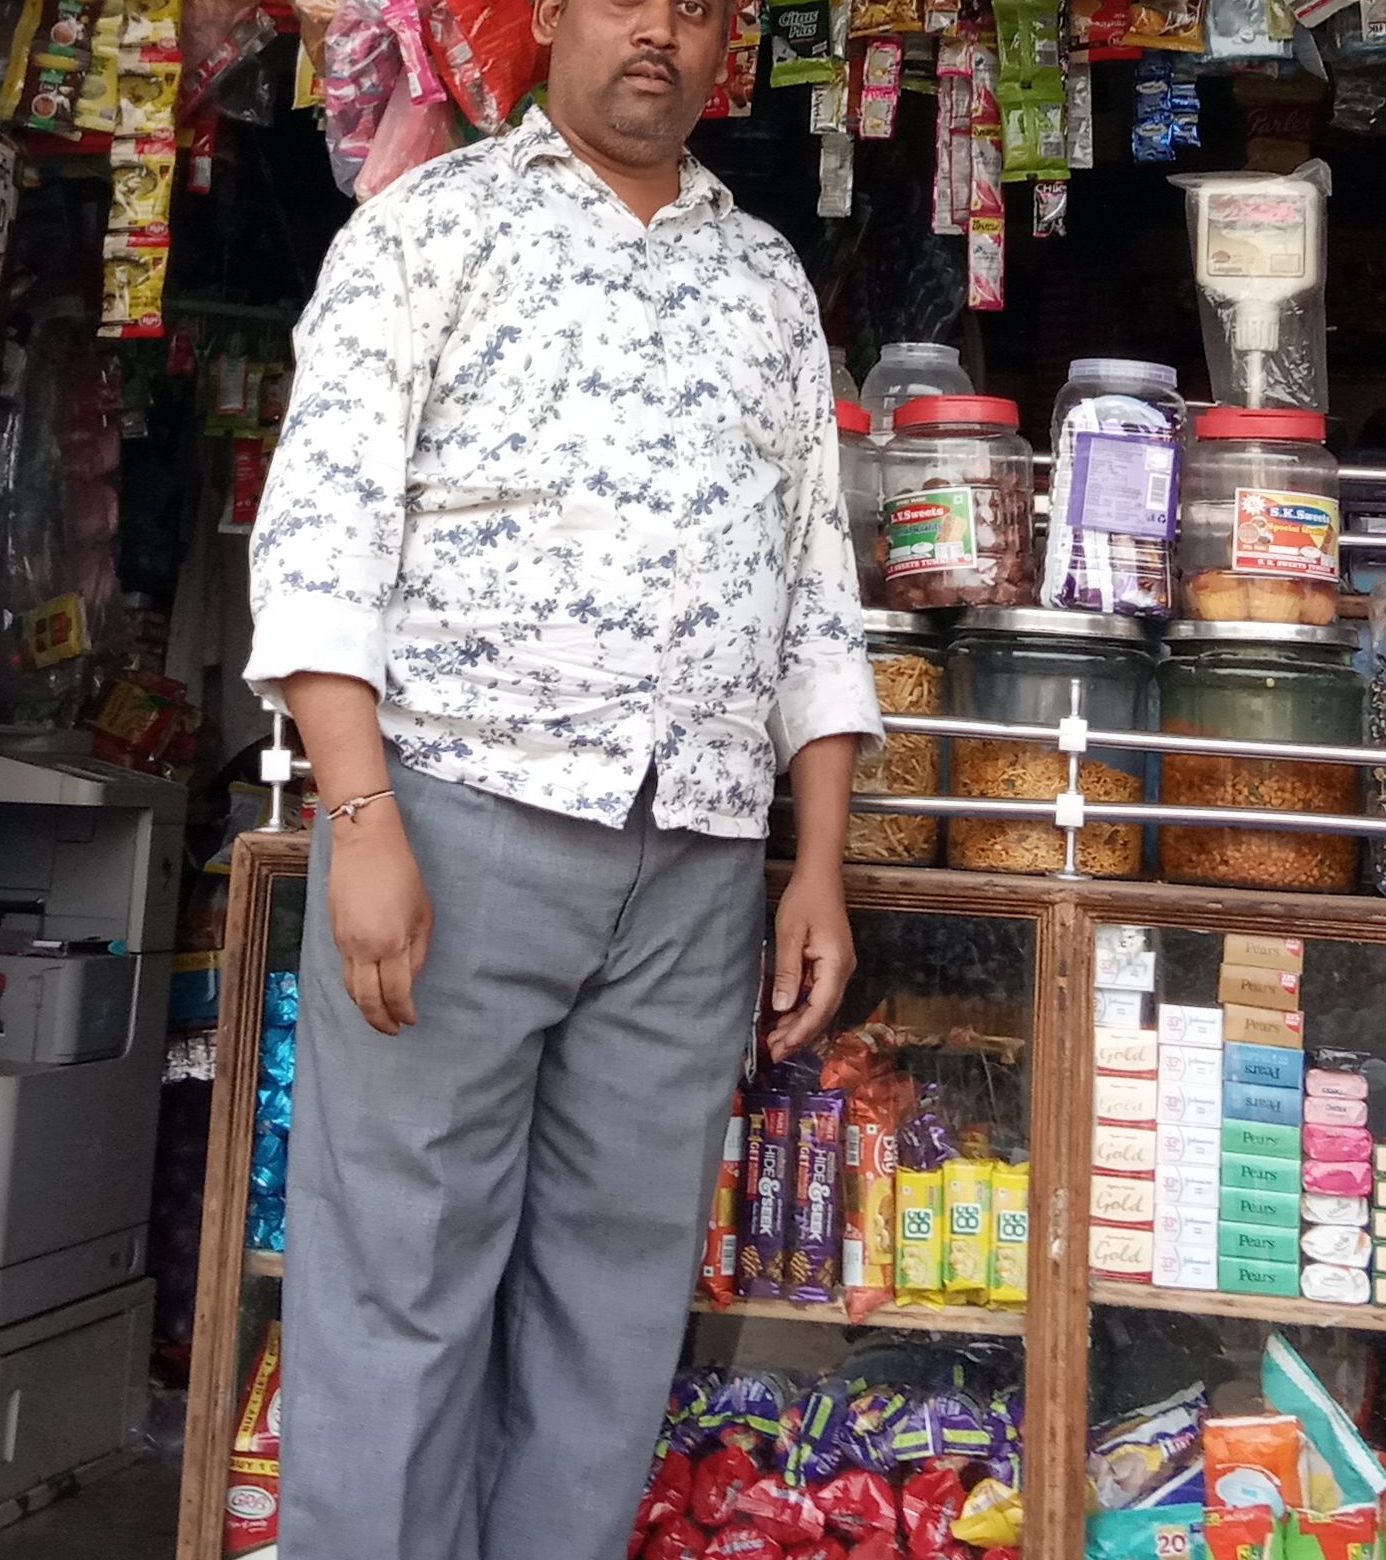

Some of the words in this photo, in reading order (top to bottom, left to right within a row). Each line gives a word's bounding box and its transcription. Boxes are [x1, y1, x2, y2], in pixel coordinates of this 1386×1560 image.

[778, 10, 819, 28] Citrus
[788, 23, 817, 39] Plus
[764, 1143, 777, 1183] HIDE
[813, 1149, 827, 1186] HIDE
[1240, 1164, 1278, 1182] Pears
[758, 1176, 781, 1201] &
[808, 1181, 831, 1205] &
[1096, 1190, 1144, 1215] Gold
[1240, 1199, 1277, 1216] Pears
[760, 1198, 774, 1238] SEEK
[809, 1202, 824, 1243] SEEK
[1094, 1240, 1143, 1264] Gold
[1238, 1233, 1276, 1250] Pears
[1238, 1267, 1276, 1284] Pears
[1158, 1534, 1187, 1553] 20
